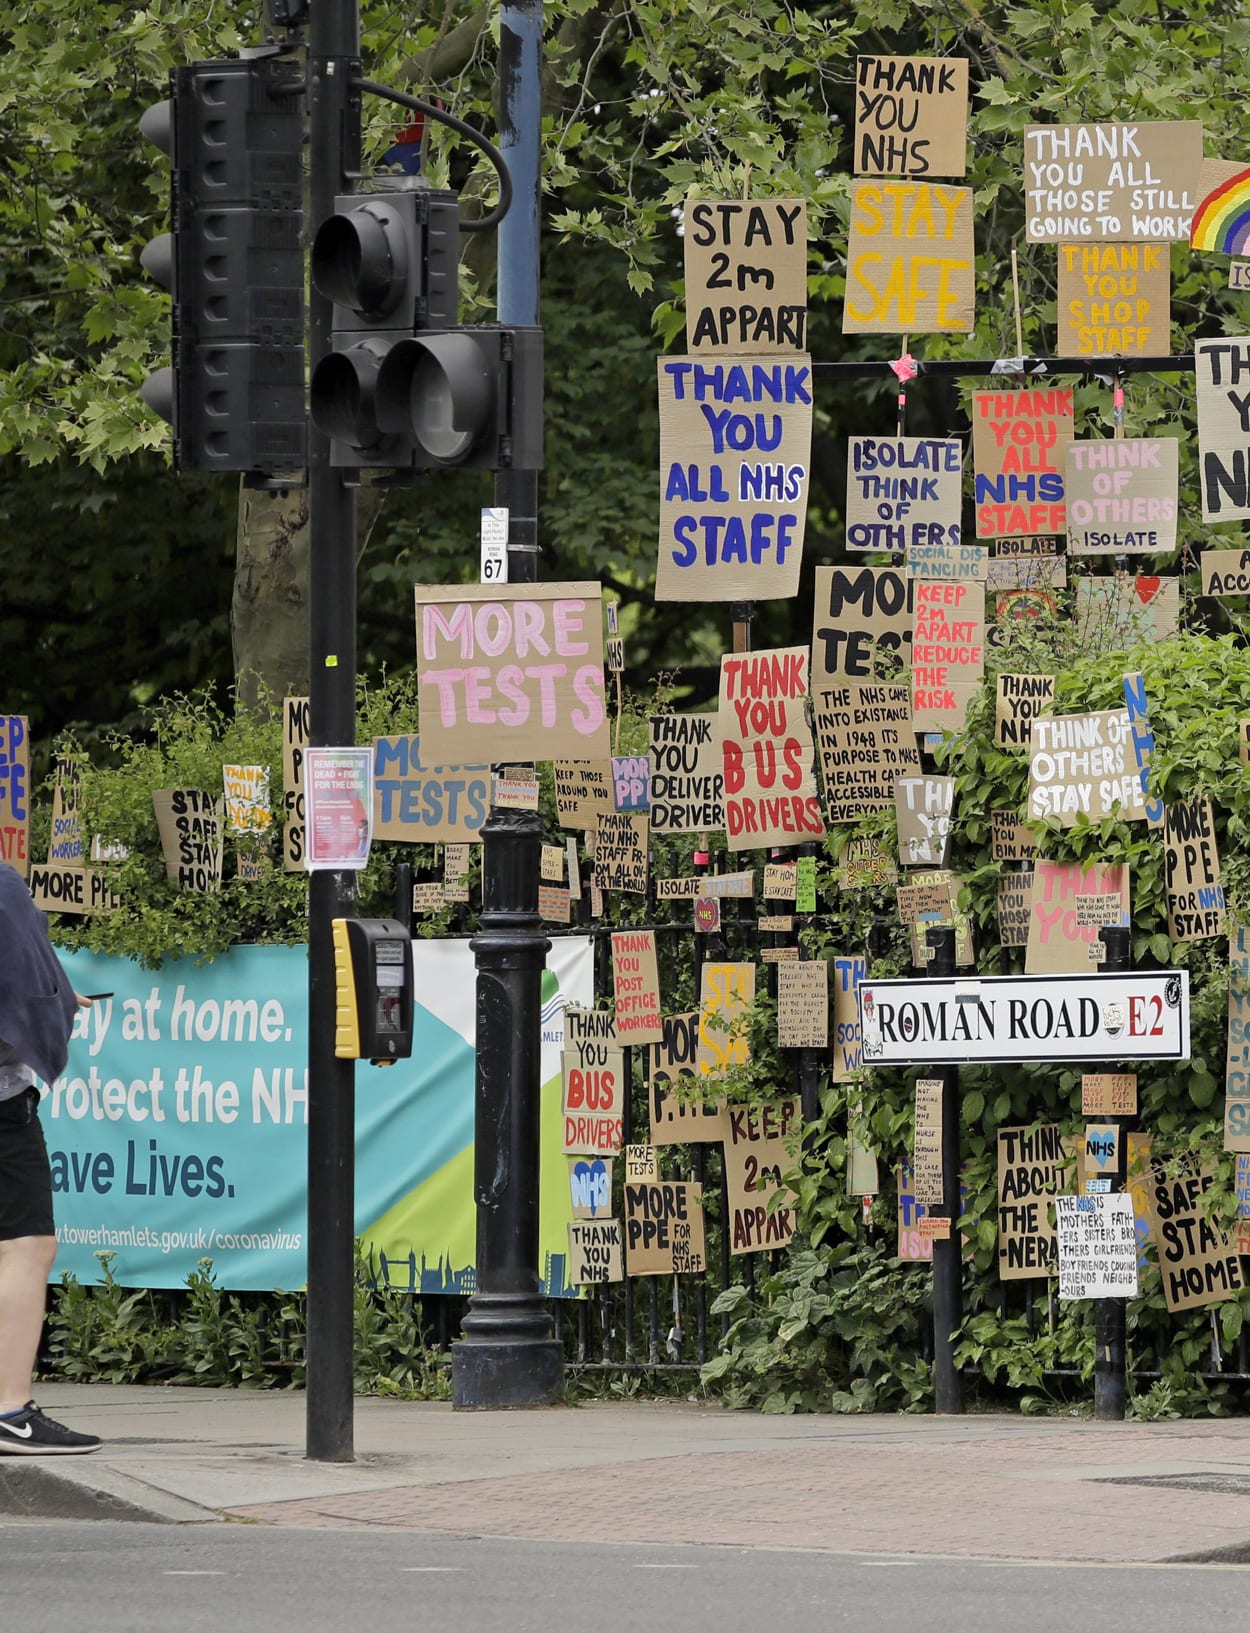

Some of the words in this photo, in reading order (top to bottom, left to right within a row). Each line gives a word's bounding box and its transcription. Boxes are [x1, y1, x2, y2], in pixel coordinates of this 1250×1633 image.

[859, 58, 955, 93] THANK
[1030, 162, 1082, 187] YOU
[1108, 162, 1161, 188] ALL
[1029, 190, 1112, 213] THOSE
[1131, 189, 1194, 210] STILL
[693, 204, 801, 247] STAY
[1029, 217, 1091, 237] GOING
[1096, 216, 1120, 234] TO
[1132, 215, 1191, 238] WORK
[1061, 246, 1161, 272] THANK
[706, 253, 774, 291] 2m
[848, 252, 970, 328] SAFE
[1083, 275, 1137, 297] YOU
[1069, 300, 1149, 328] SHOP
[1078, 326, 1151, 352] STAFF
[976, 394, 1074, 418] THANK
[854, 440, 960, 472] ISOLATE
[1069, 444, 1160, 470] THINK
[665, 463, 729, 502] ALL
[739, 461, 804, 502] NHS
[856, 475, 939, 501] THINK
[1093, 471, 1133, 495] OF
[877, 501, 911, 521] OF
[1070, 498, 1175, 525] OTHERS
[484, 560, 502, 578] 67
[917, 585, 966, 607] KEEP
[423, 599, 589, 660] MORE
[419, 664, 604, 737] TESTS
[651, 717, 711, 744] THANK
[734, 699, 786, 738] YOU
[818, 712, 850, 730] INTO
[855, 707, 908, 724] EXISTANCE
[821, 733, 838, 748] IN
[848, 729, 875, 747] 1948
[881, 727, 898, 743] IT'S
[1034, 718, 1102, 749] THINK
[1108, 713, 1132, 745] OF
[824, 750, 880, 767] PURPOSE
[883, 750, 896, 763] TO
[898, 748, 918, 764] MAKE
[172, 791, 217, 814] STAY
[226, 782, 252, 800] YOU
[599, 813, 632, 829] THANK
[1166, 800, 1210, 845] MORE
[181, 843, 218, 867] STAY
[32, 869, 83, 905] MORE
[660, 879, 700, 895] ISOLATE
[1000, 896, 1022, 907] YOU
[1169, 894, 1196, 914] FOR
[1198, 886, 1224, 909] NHS
[1176, 912, 1218, 936] STAFF
[613, 935, 651, 951] THANK
[616, 958, 639, 972] YOU
[616, 977, 643, 995] POST
[121, 993, 162, 1041] at
[171, 985, 293, 1041] home.
[876, 1001, 996, 1043] ROMAN
[1008, 998, 1099, 1040] ROAD
[1128, 995, 1164, 1037] E2
[576, 1041, 608, 1069] YOU
[175, 1069, 237, 1123] the
[252, 1068, 308, 1124] NH
[566, 1118, 622, 1149] DRIVERS
[1086, 1139, 1115, 1156] NHS
[51, 1151, 114, 1196] ave
[126, 1140, 234, 1199] Lives.
[1000, 1203, 1039, 1234] THE
[1060, 1214, 1104, 1229] MOTHERS
[1111, 1214, 1132, 1226] FATH-
[572, 1226, 619, 1245] THANK
[1060, 1231, 1078, 1243] -ERS
[1084, 1229, 1115, 1242] SISTERS
[1121, 1228, 1135, 1240] BRO
[583, 1247, 610, 1265] YOU
[1059, 1246, 1089, 1257] -THERS
[1094, 1244, 1136, 1256] GIRLFRIENDS
[581, 1265, 609, 1282] NHS
[1111, 1259, 1135, 1271] COUSINS
[1061, 1273, 1096, 1285] FRIENDS
[1102, 1271, 1136, 1284] NEIGHB-
[1060, 1286, 1086, 1296] -OURS
